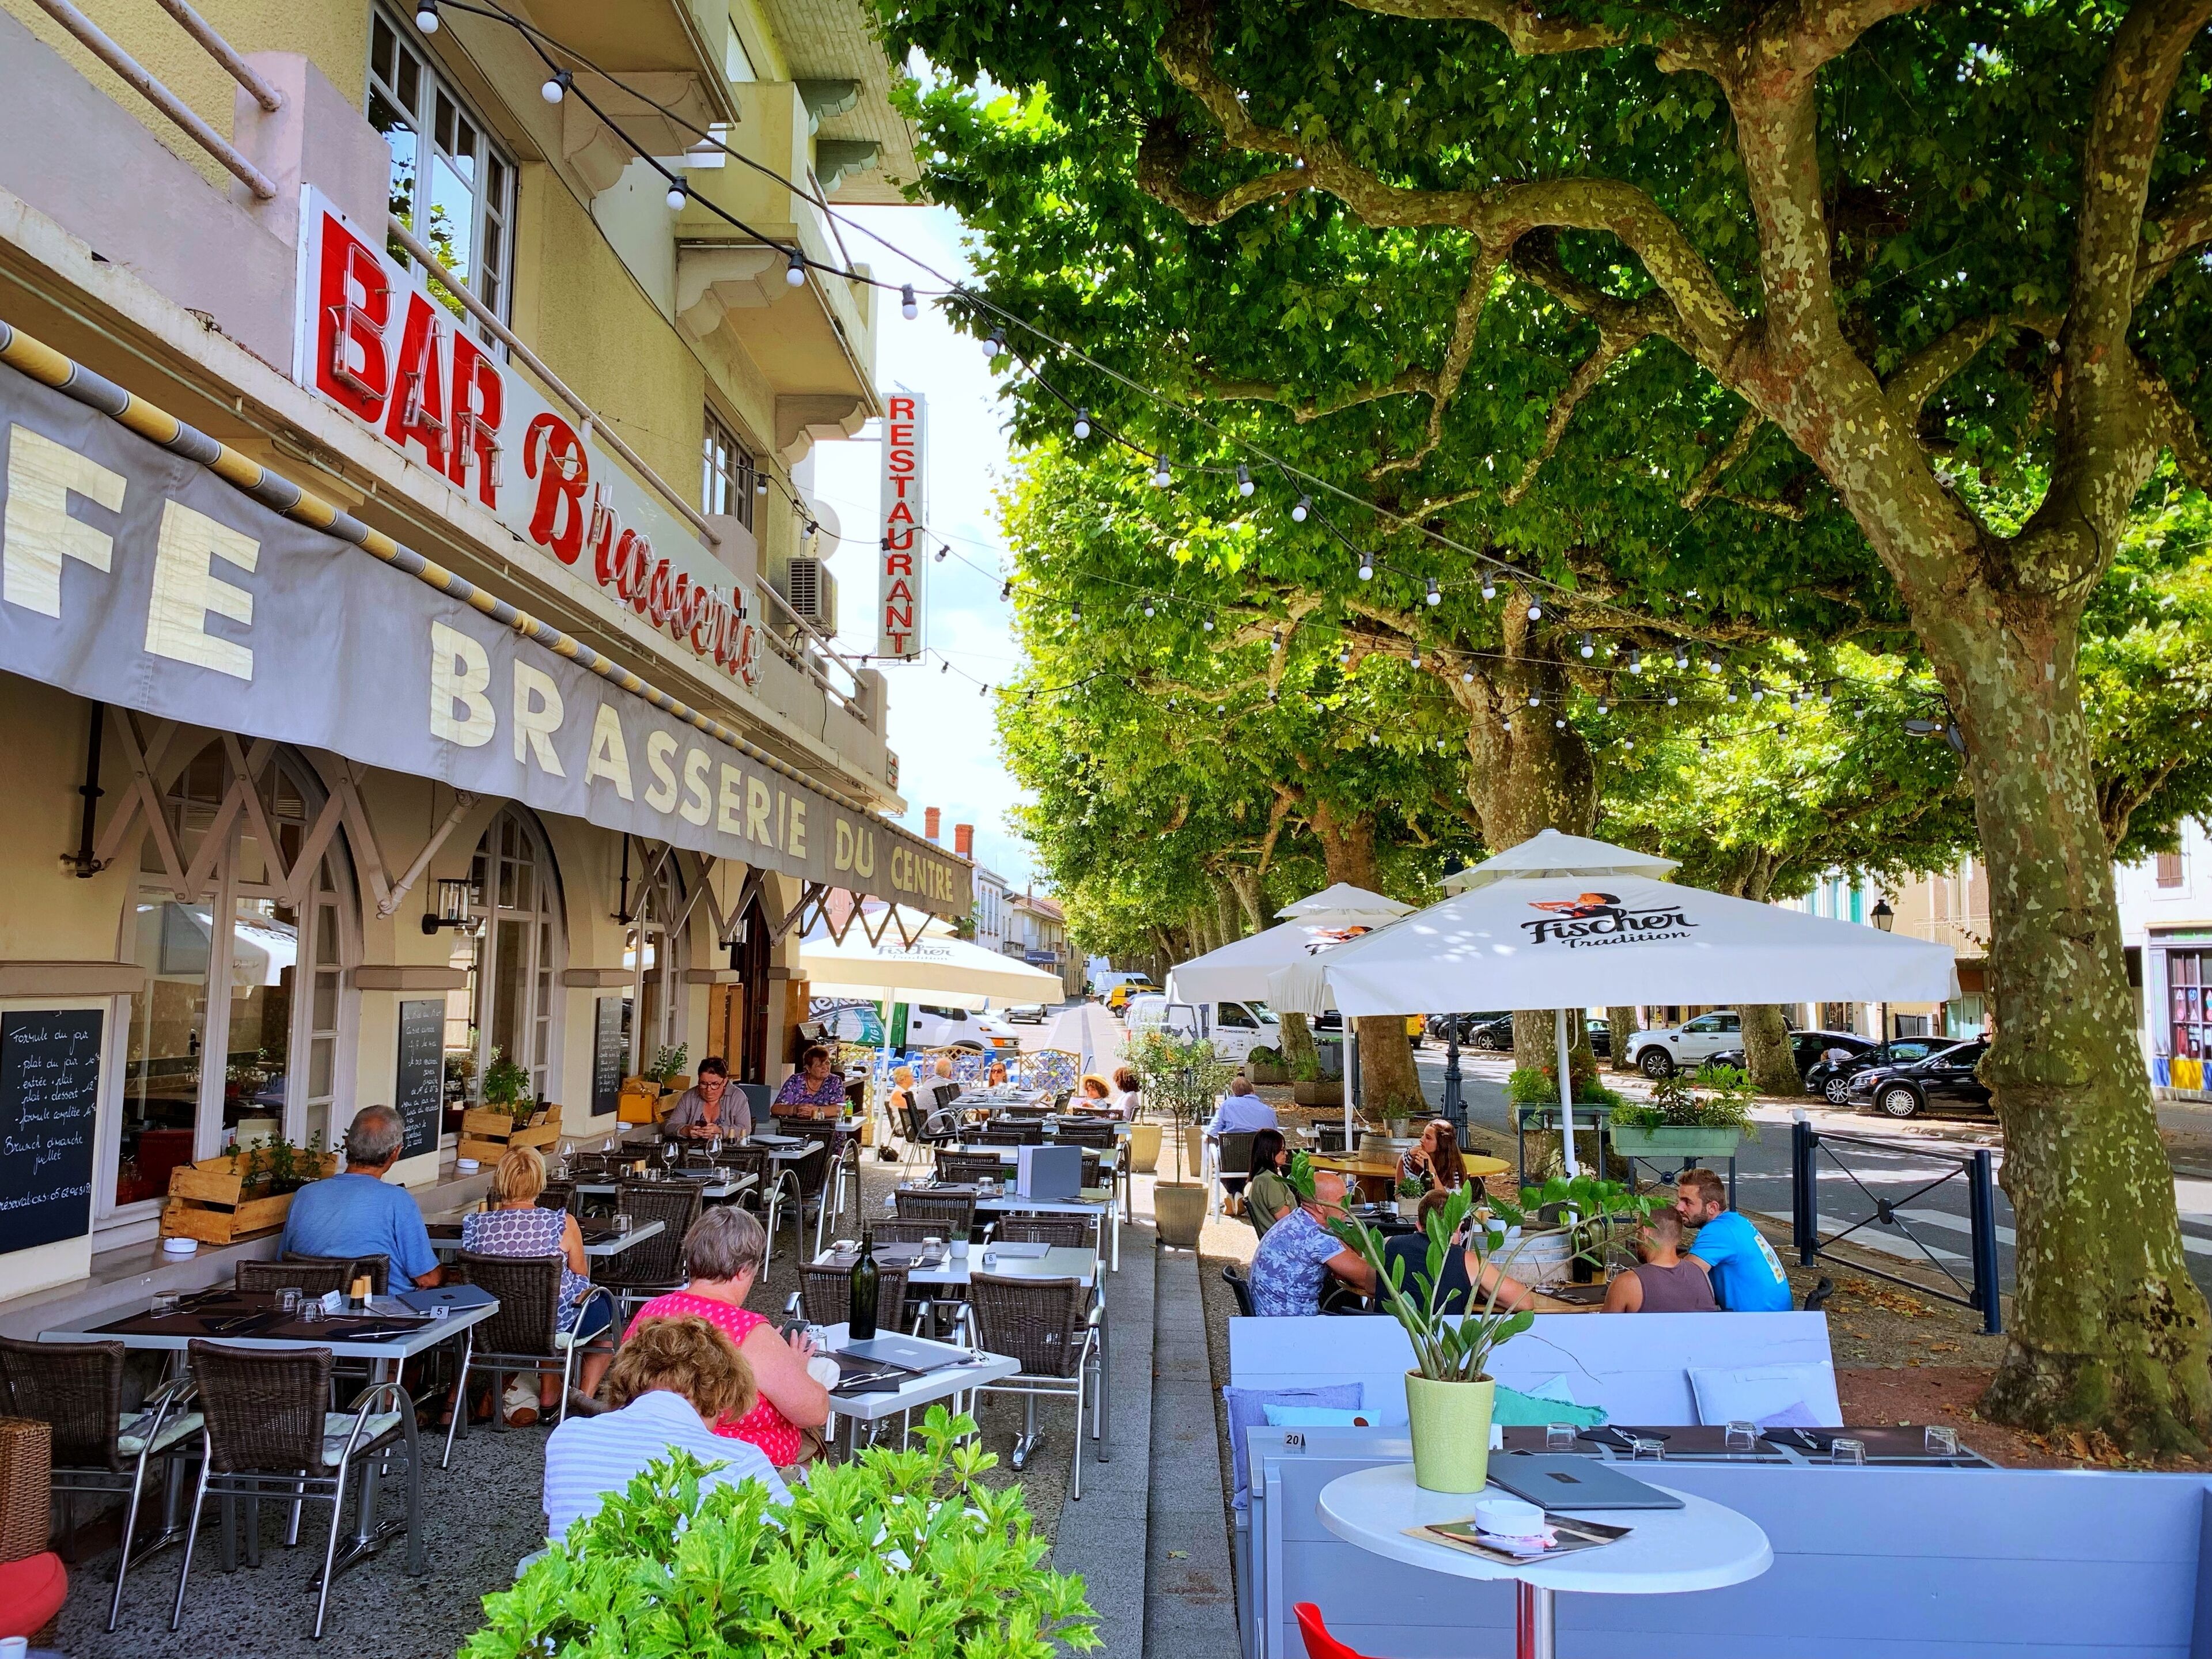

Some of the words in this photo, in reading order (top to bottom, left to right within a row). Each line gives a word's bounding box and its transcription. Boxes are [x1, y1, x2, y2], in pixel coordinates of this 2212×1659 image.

[316, 210, 507, 511] BAR
[886, 398, 914, 654] RESTAURANT
[430, 620, 807, 859] BRASSERIE
[834, 817, 874, 879] DU
[891, 844, 954, 903] CENTRE
[1521, 906, 1701, 944] Fischer
[1562, 931, 1691, 948] Tradition
[54, 1029, 67, 1040] du
[69, 1030, 88, 1055] jour
[47, 1058, 58, 1069] du
[63, 1058, 78, 1075] jour
[3, 1134, 41, 1156] Brunch
[436, 1307, 443, 1315] 5
[1286, 1434, 1299, 1445] 20
